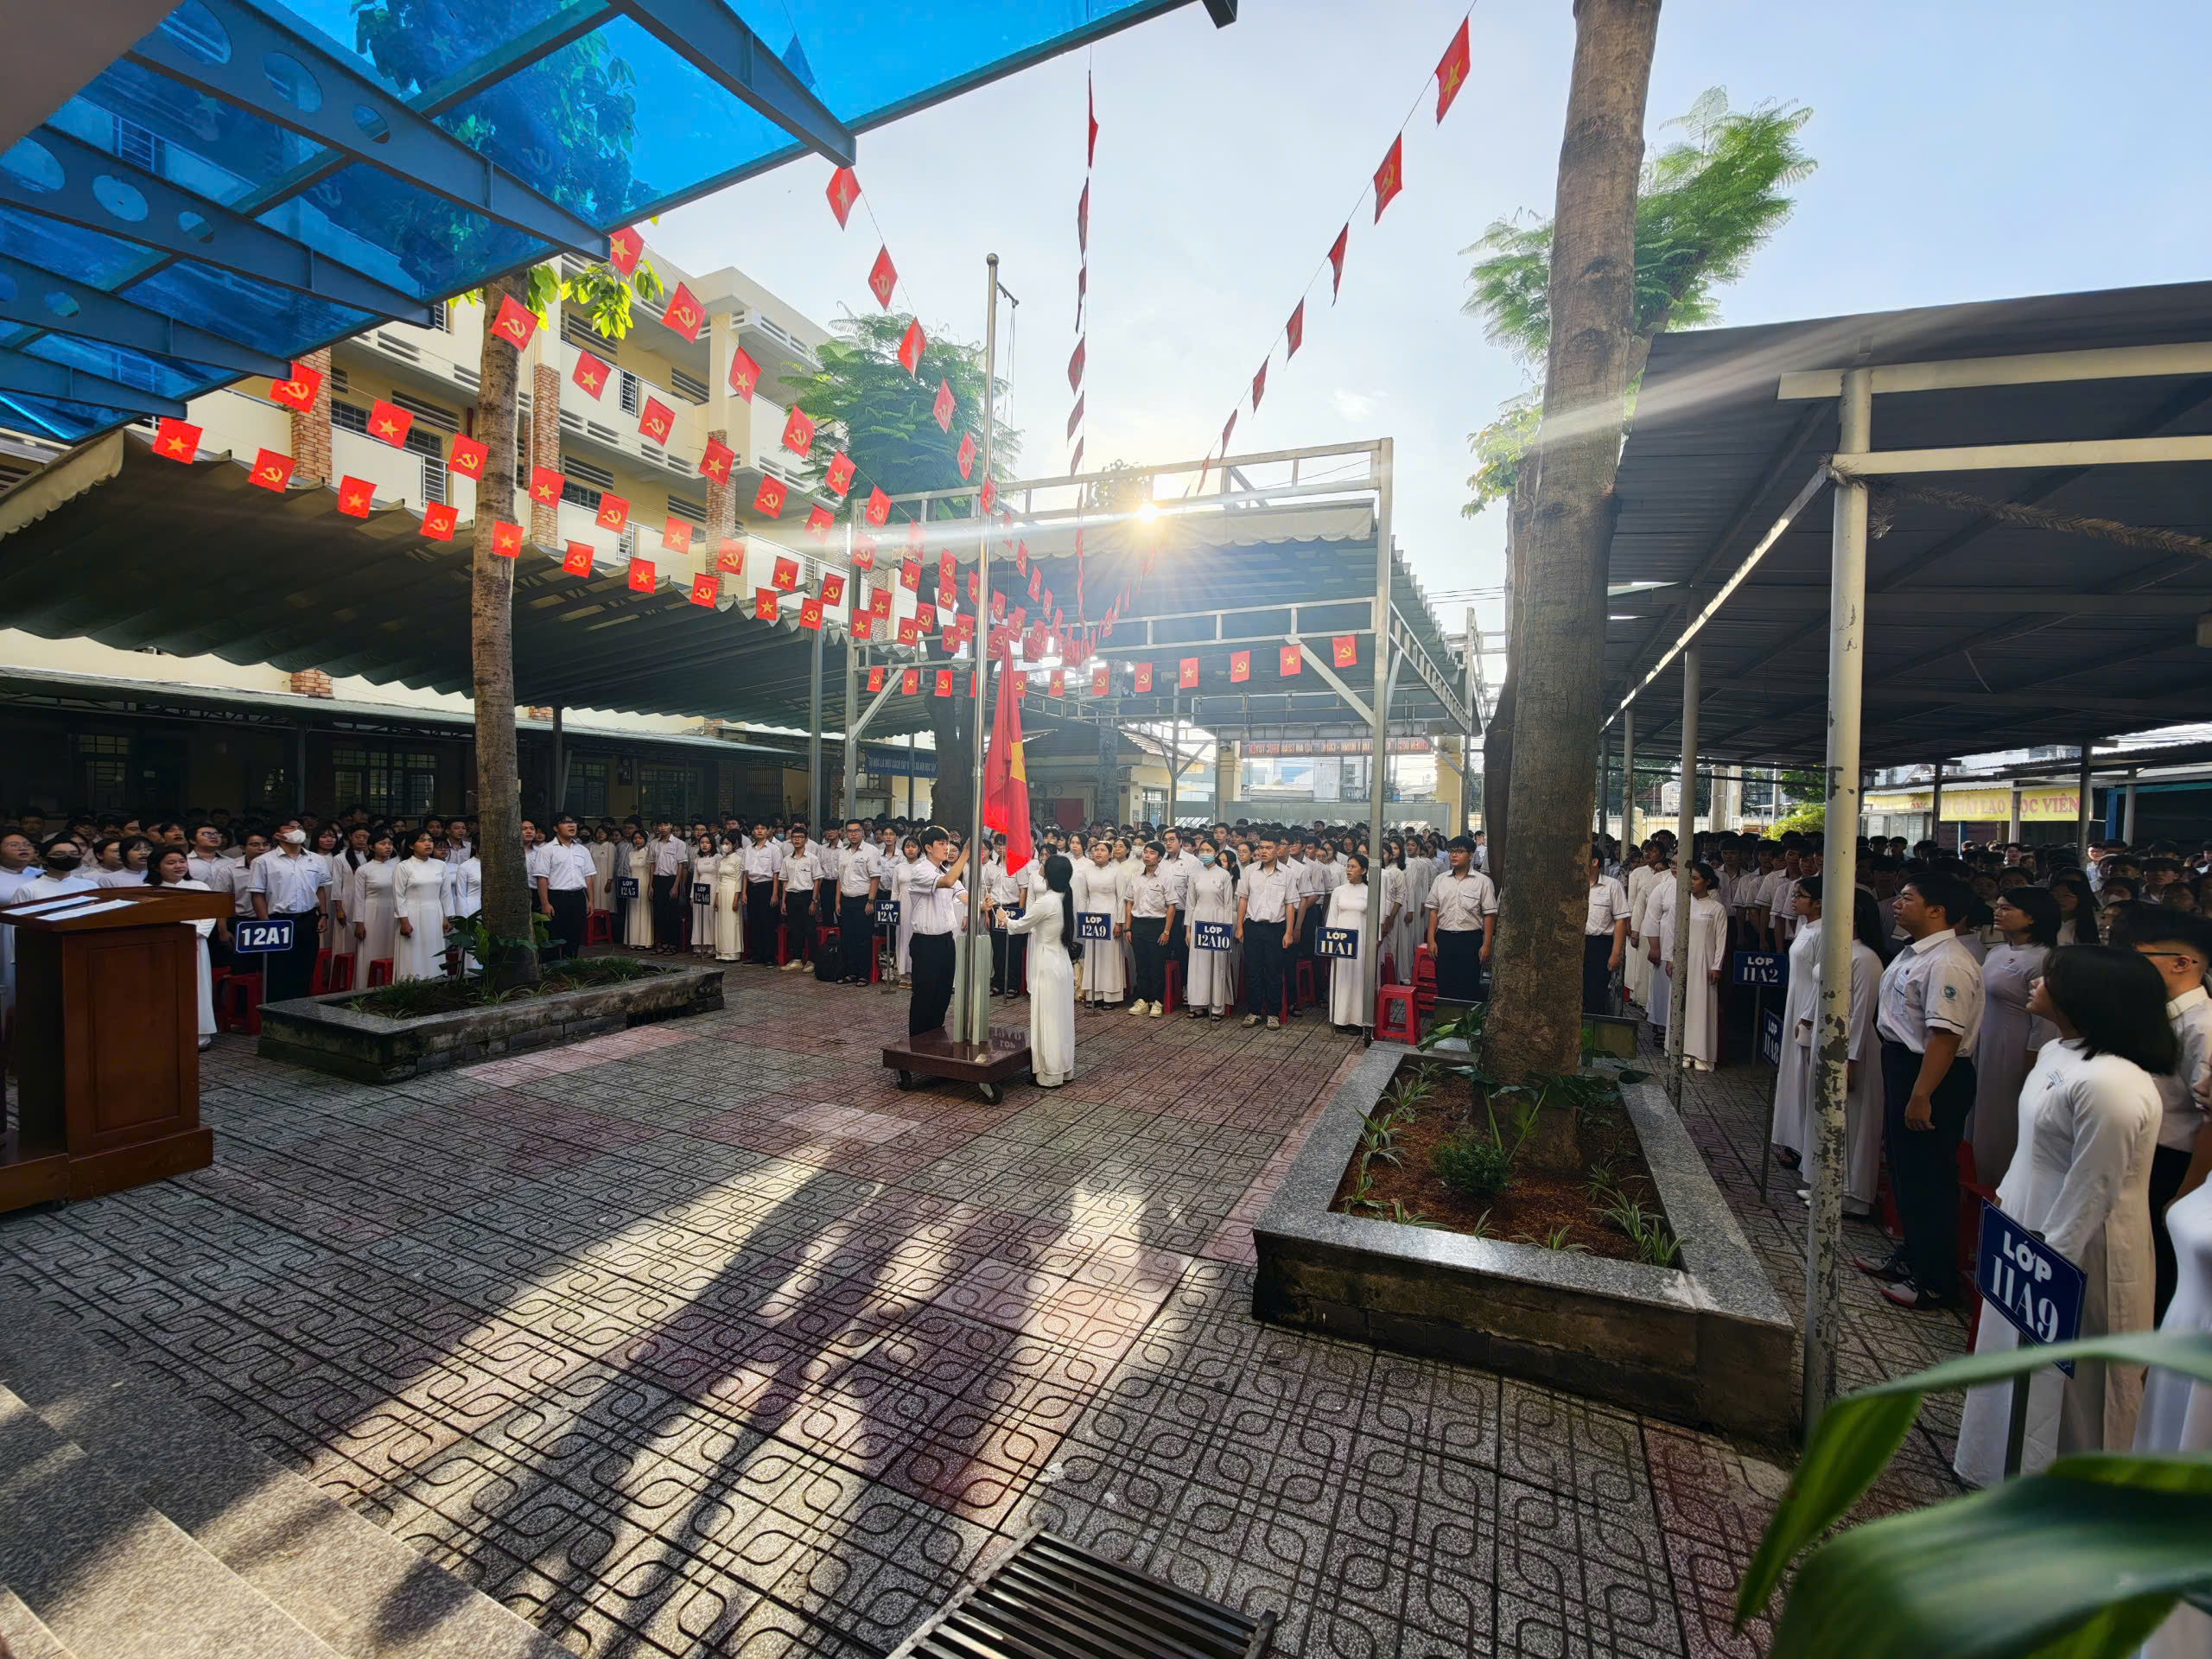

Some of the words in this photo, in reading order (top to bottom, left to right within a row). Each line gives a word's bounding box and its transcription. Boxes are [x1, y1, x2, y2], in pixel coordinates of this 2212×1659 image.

[877, 911, 899, 922] 12A7
[242, 926, 289, 946] 12A1
[1082, 925, 1106, 938] 12A9
[1197, 934, 1230, 949] 12A10
[1320, 940, 1353, 956] 11A1
[1743, 967, 1778, 982] 11A2
[2003, 1230, 2052, 1283] LỚP
[1990, 1254, 2059, 1343] 11A9
